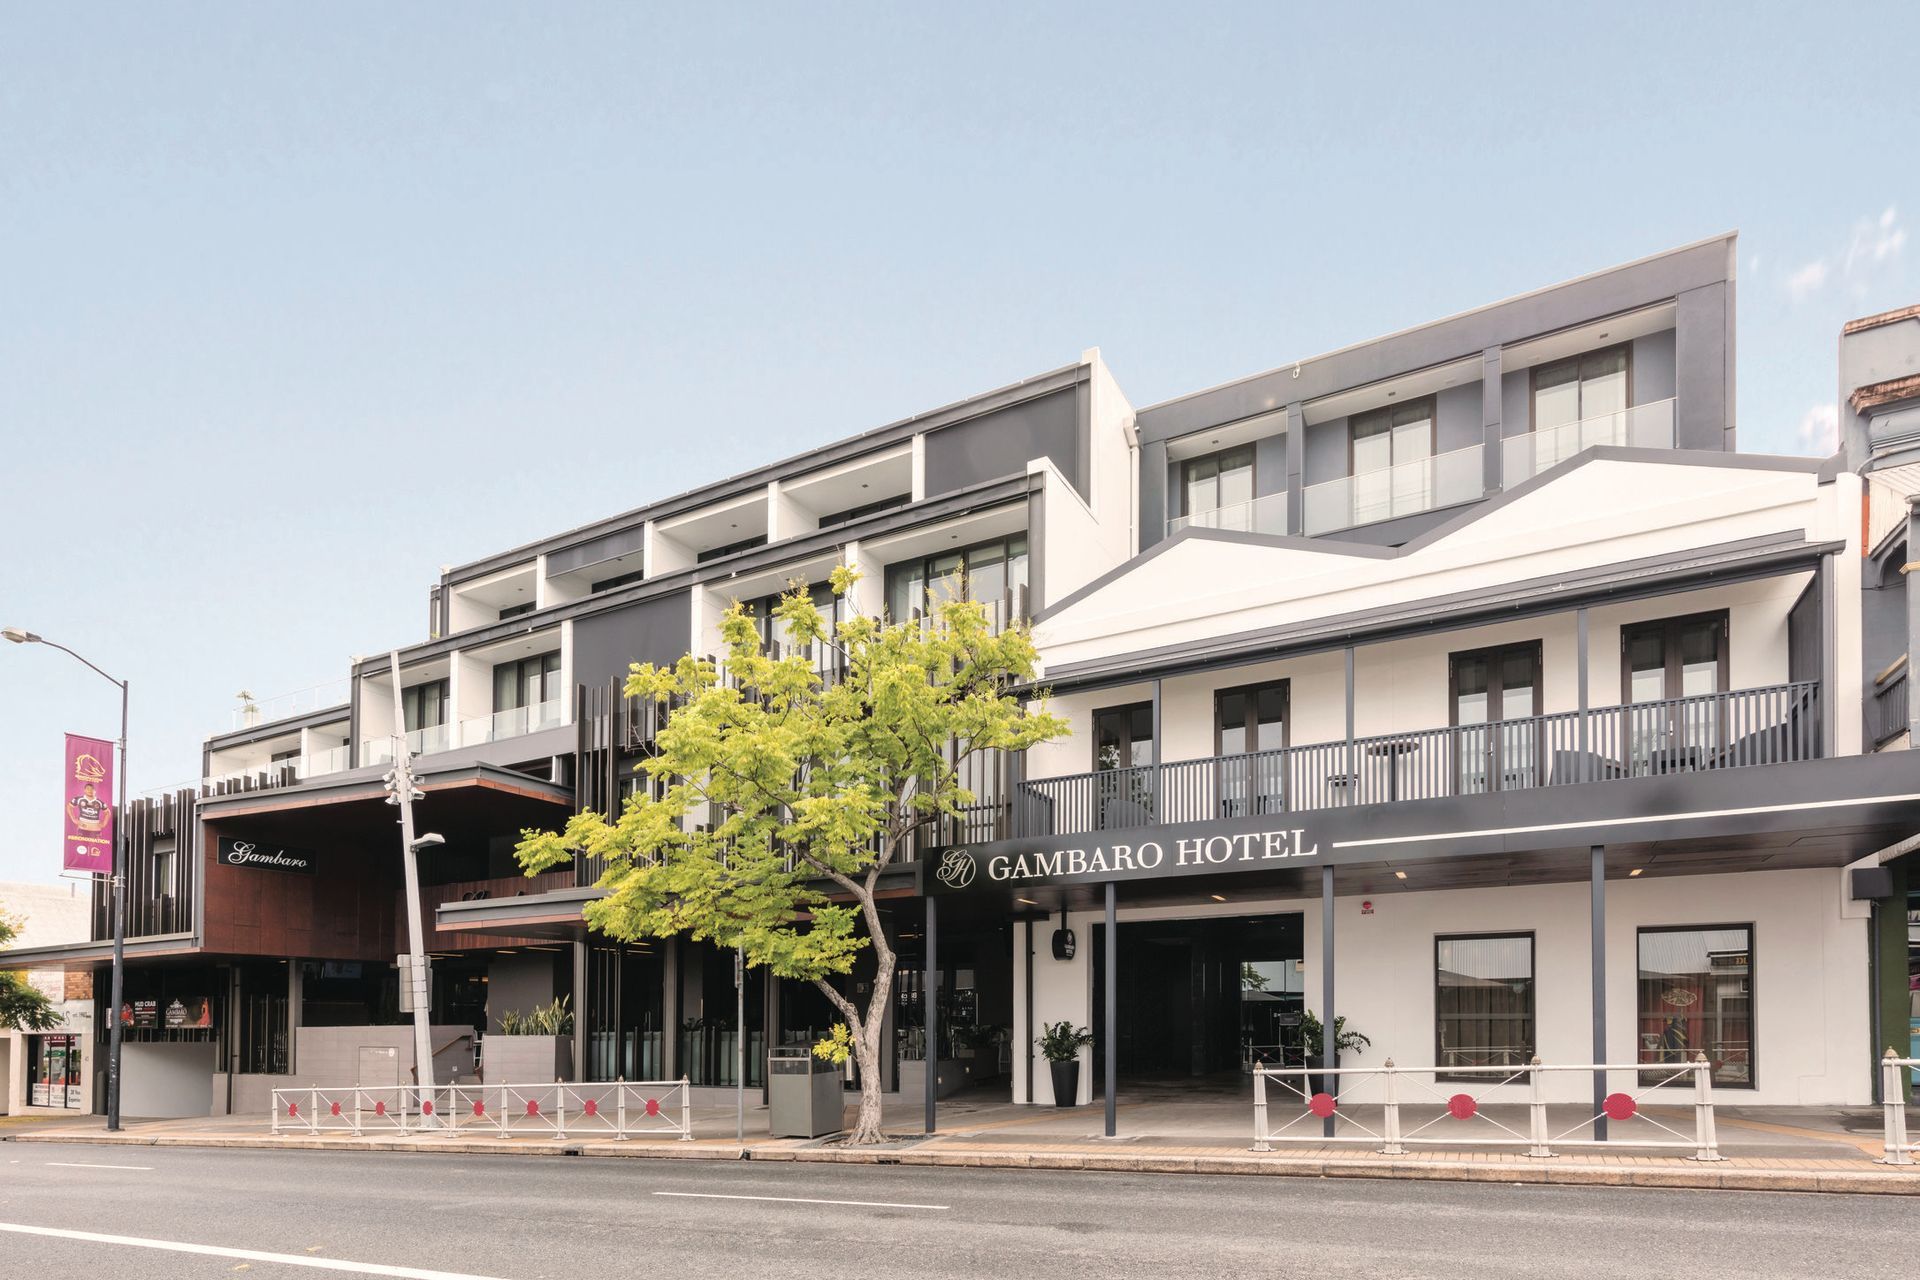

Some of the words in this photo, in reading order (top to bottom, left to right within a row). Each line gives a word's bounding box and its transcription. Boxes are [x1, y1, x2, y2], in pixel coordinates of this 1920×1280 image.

[228, 841, 307, 868] Gambaro
[988, 842, 1163, 881] GAMBARO
[1175, 829, 1318, 866] HOTEL
